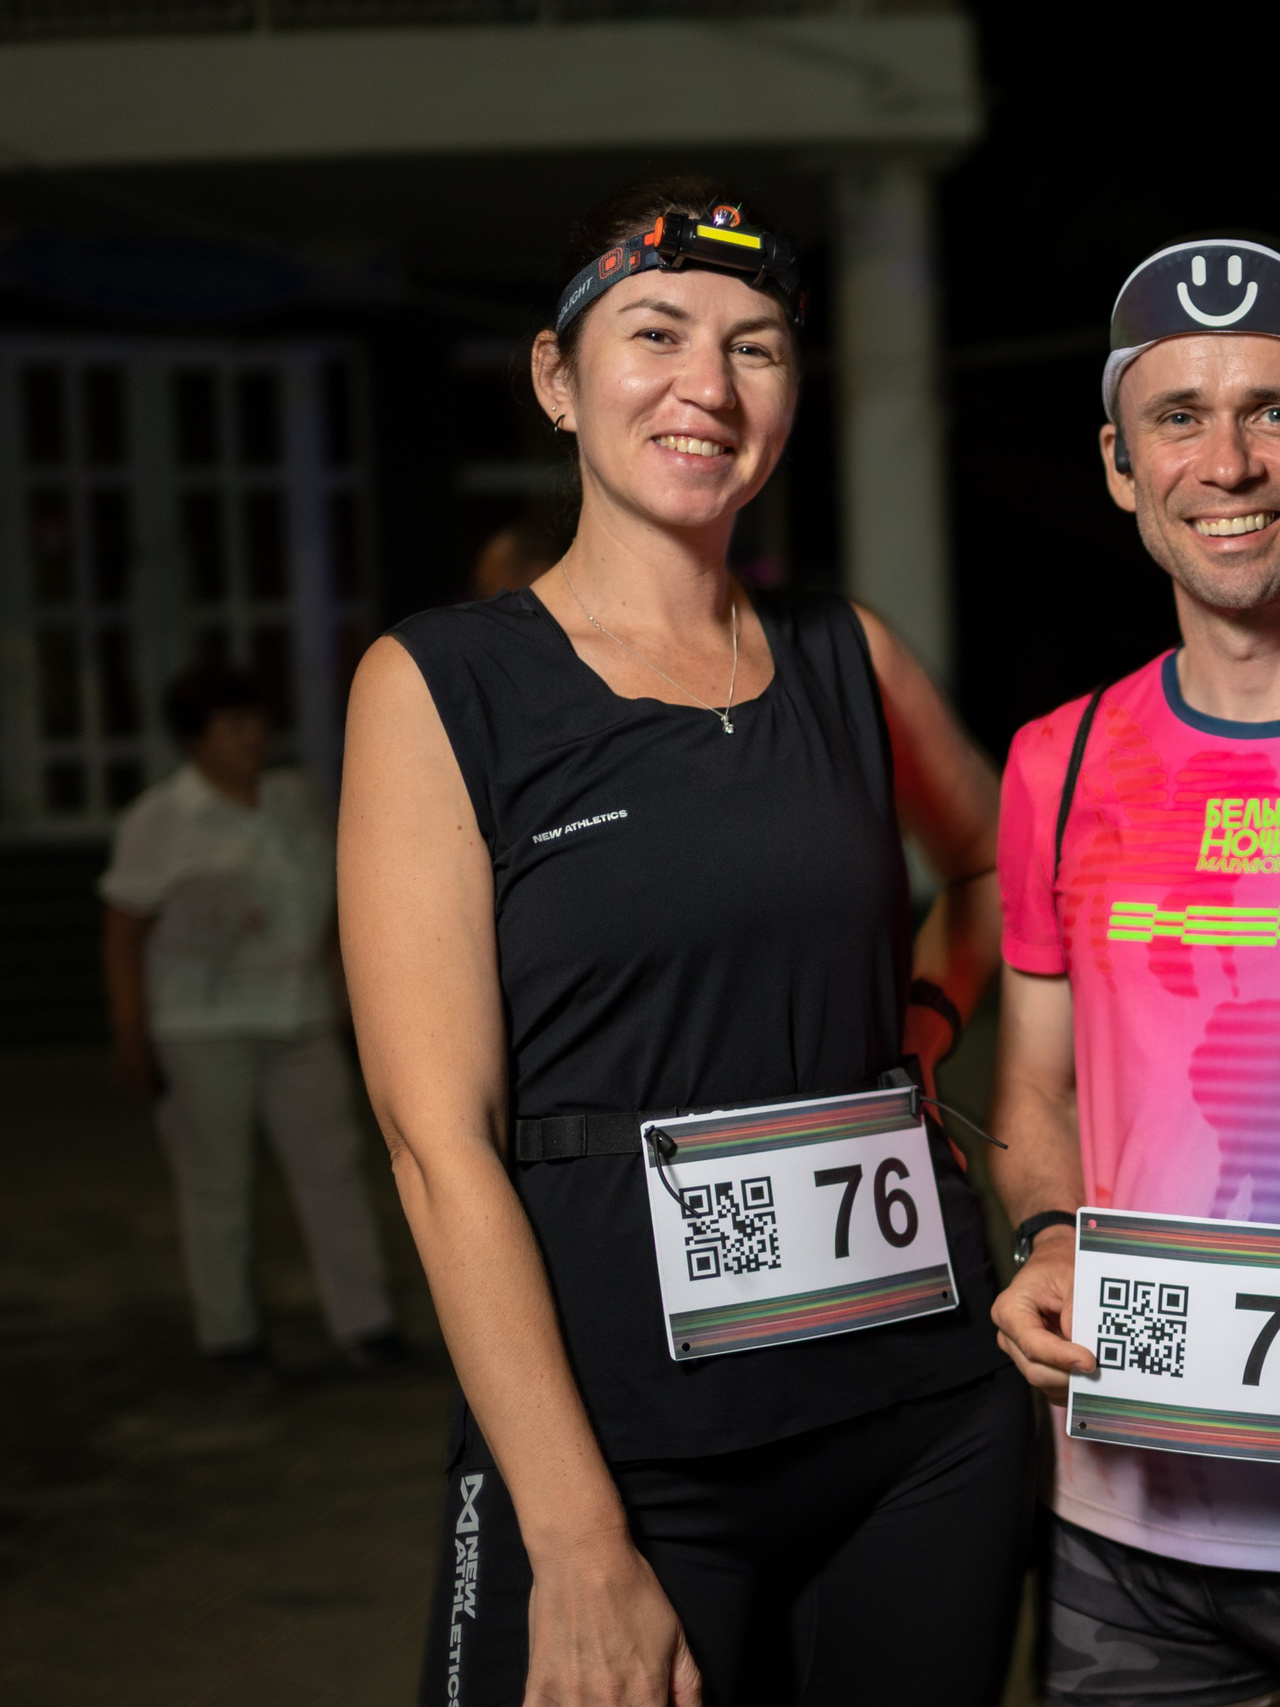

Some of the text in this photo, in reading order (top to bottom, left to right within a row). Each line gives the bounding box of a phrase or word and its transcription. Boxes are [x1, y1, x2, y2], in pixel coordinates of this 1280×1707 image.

[532, 809, 628, 844] NEW ATHLETICS
[813, 1157, 919, 1259] 76
[464, 1536, 479, 1619] NEW
